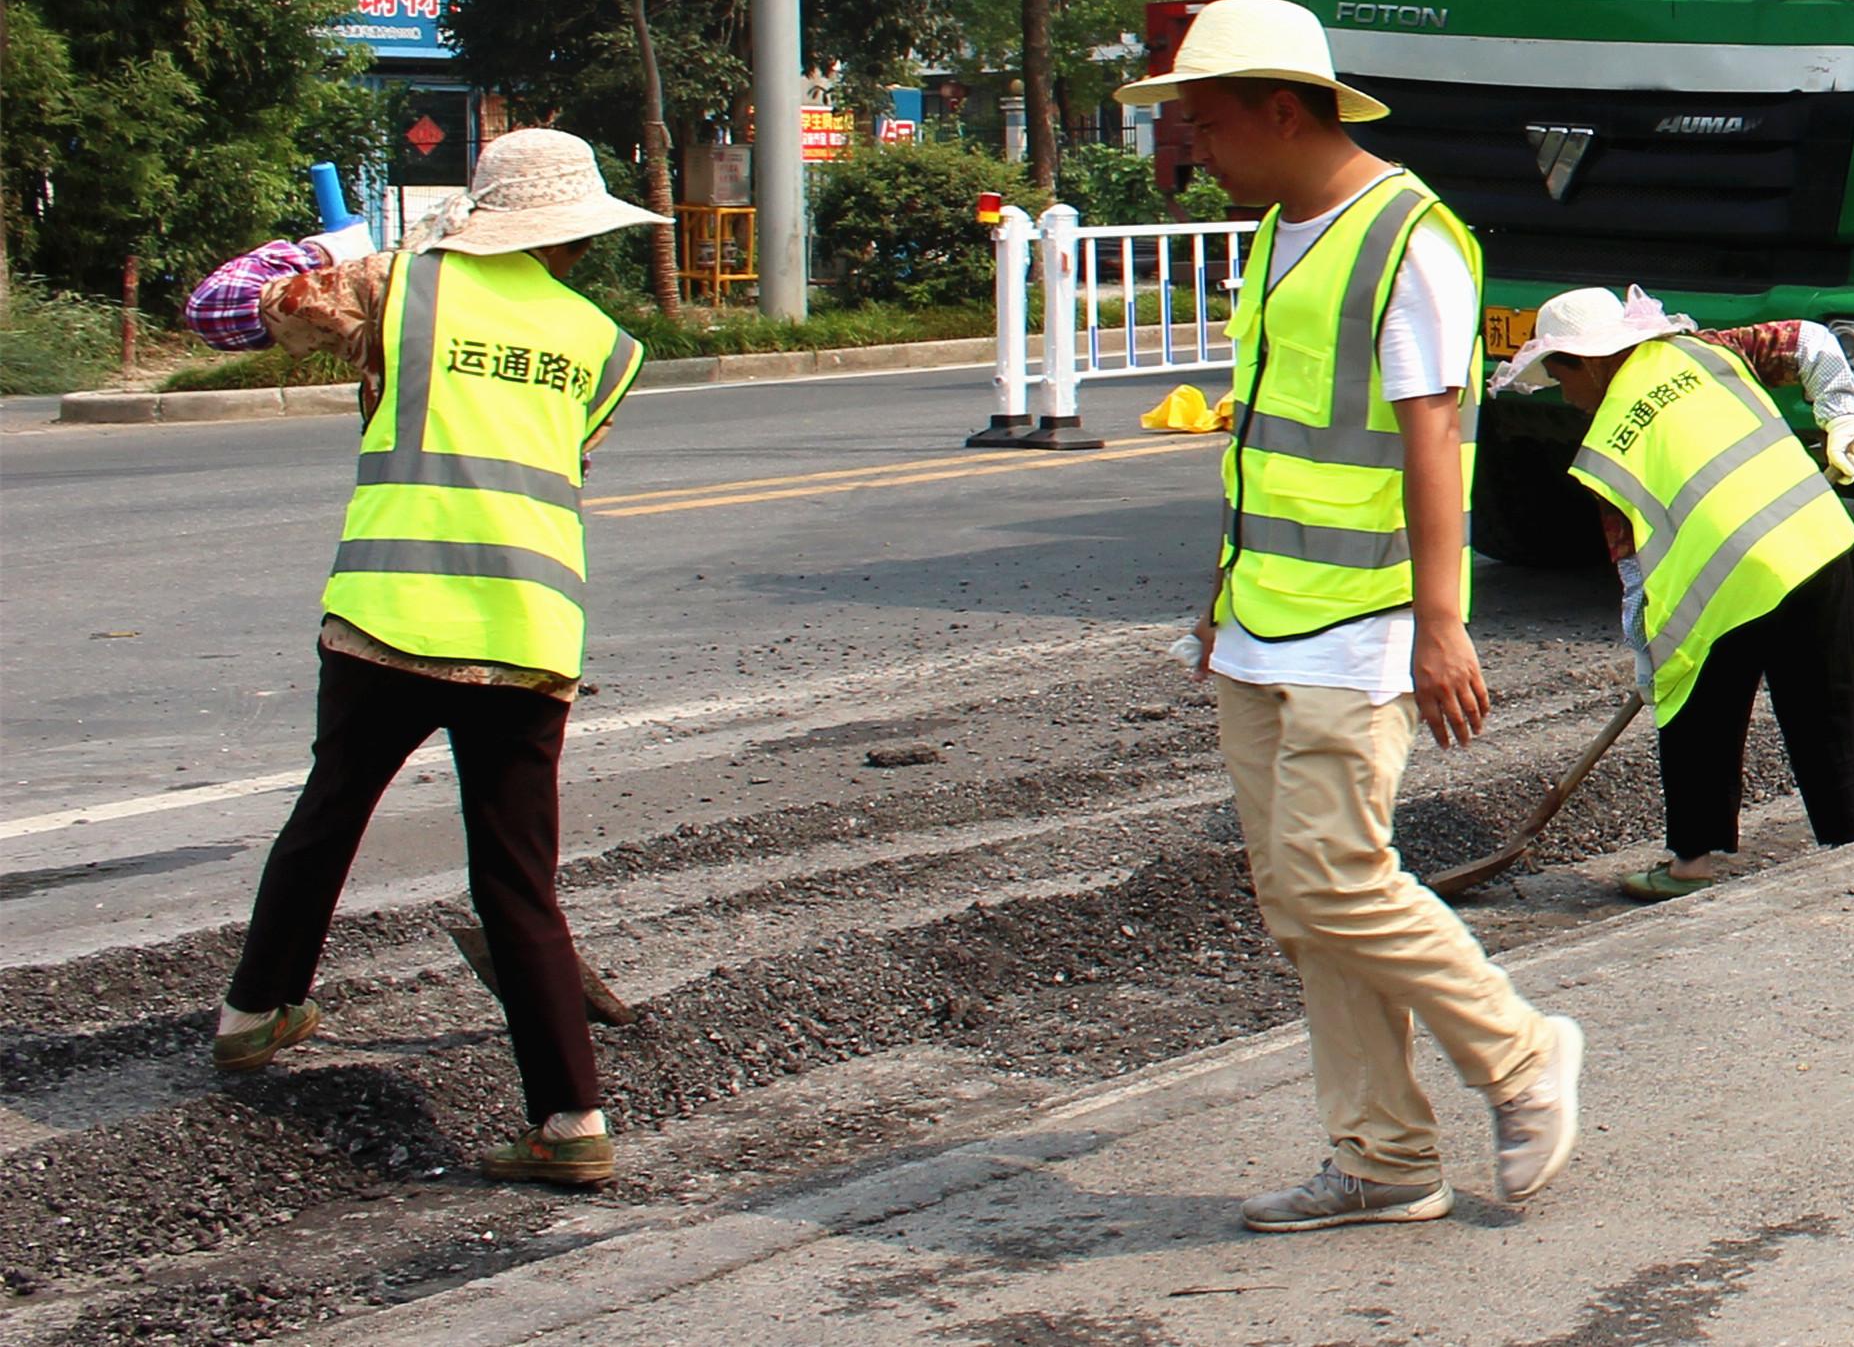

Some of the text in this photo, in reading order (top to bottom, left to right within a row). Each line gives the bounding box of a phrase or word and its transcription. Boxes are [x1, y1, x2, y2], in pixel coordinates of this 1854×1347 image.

[1336, 1, 1449, 28] FOTON
[1606, 370, 1702, 455] 运通路桥
